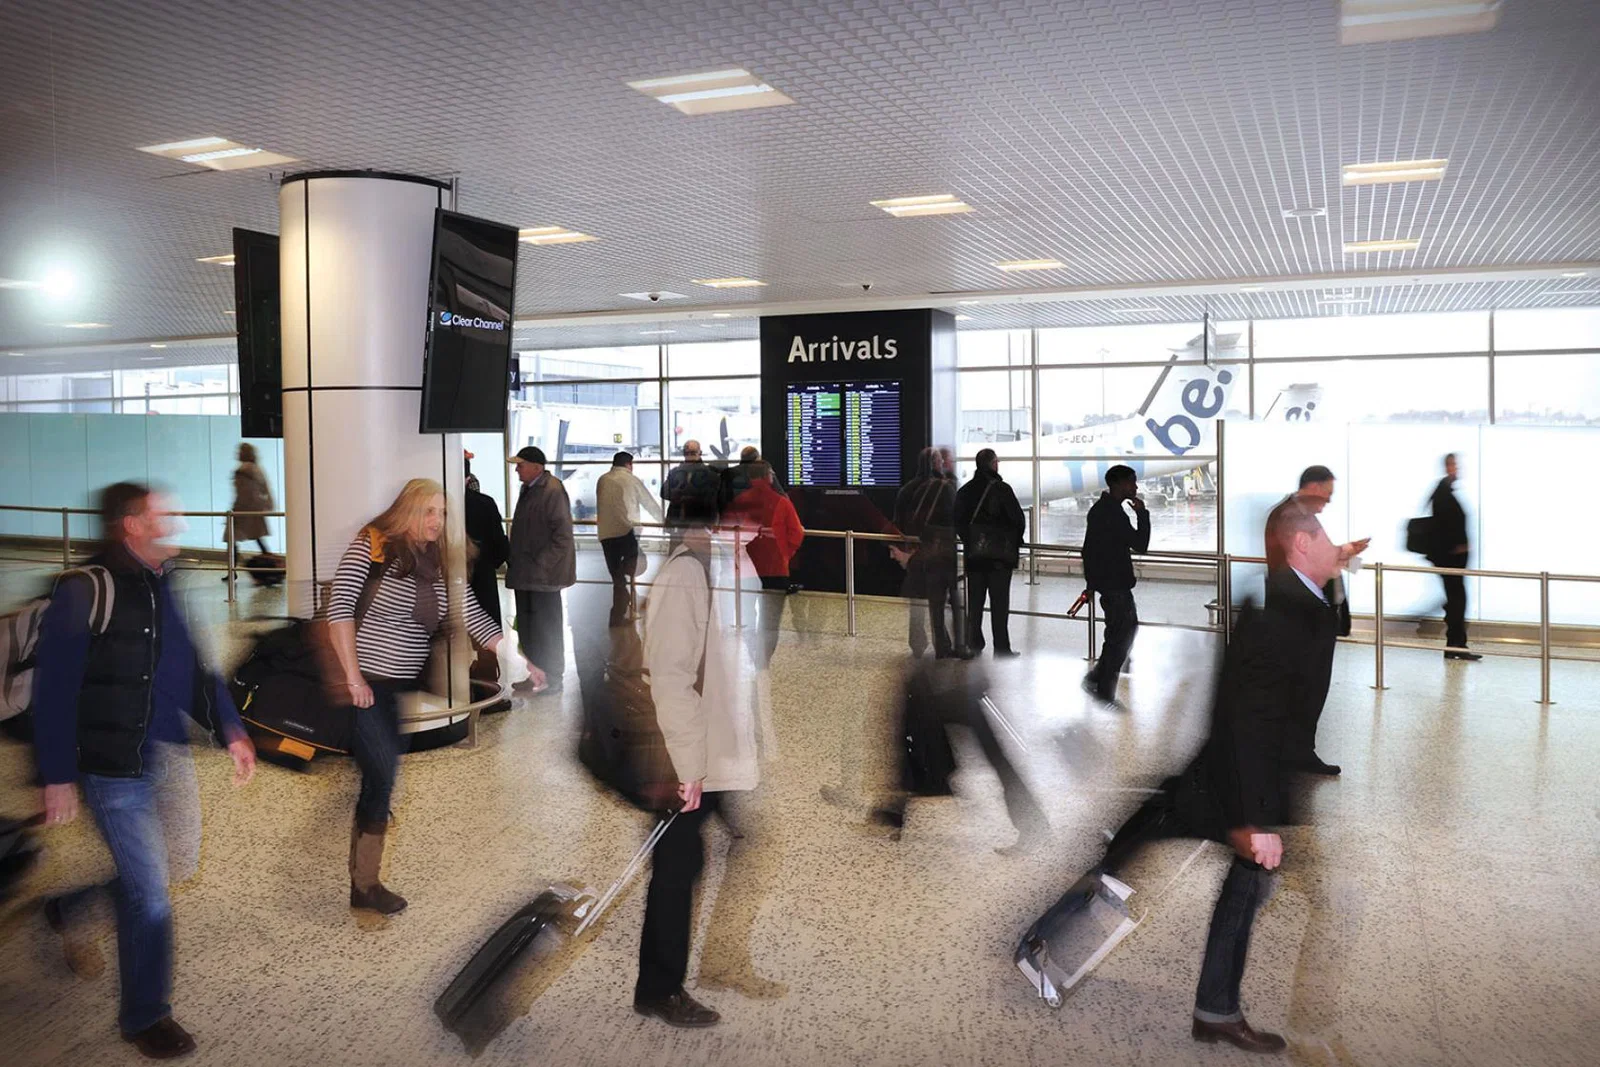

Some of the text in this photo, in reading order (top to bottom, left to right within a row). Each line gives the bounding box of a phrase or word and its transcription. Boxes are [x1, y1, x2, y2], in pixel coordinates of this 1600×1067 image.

[453, 315, 504, 331] Clear Channel
[787, 335, 898, 363] Arrivals
